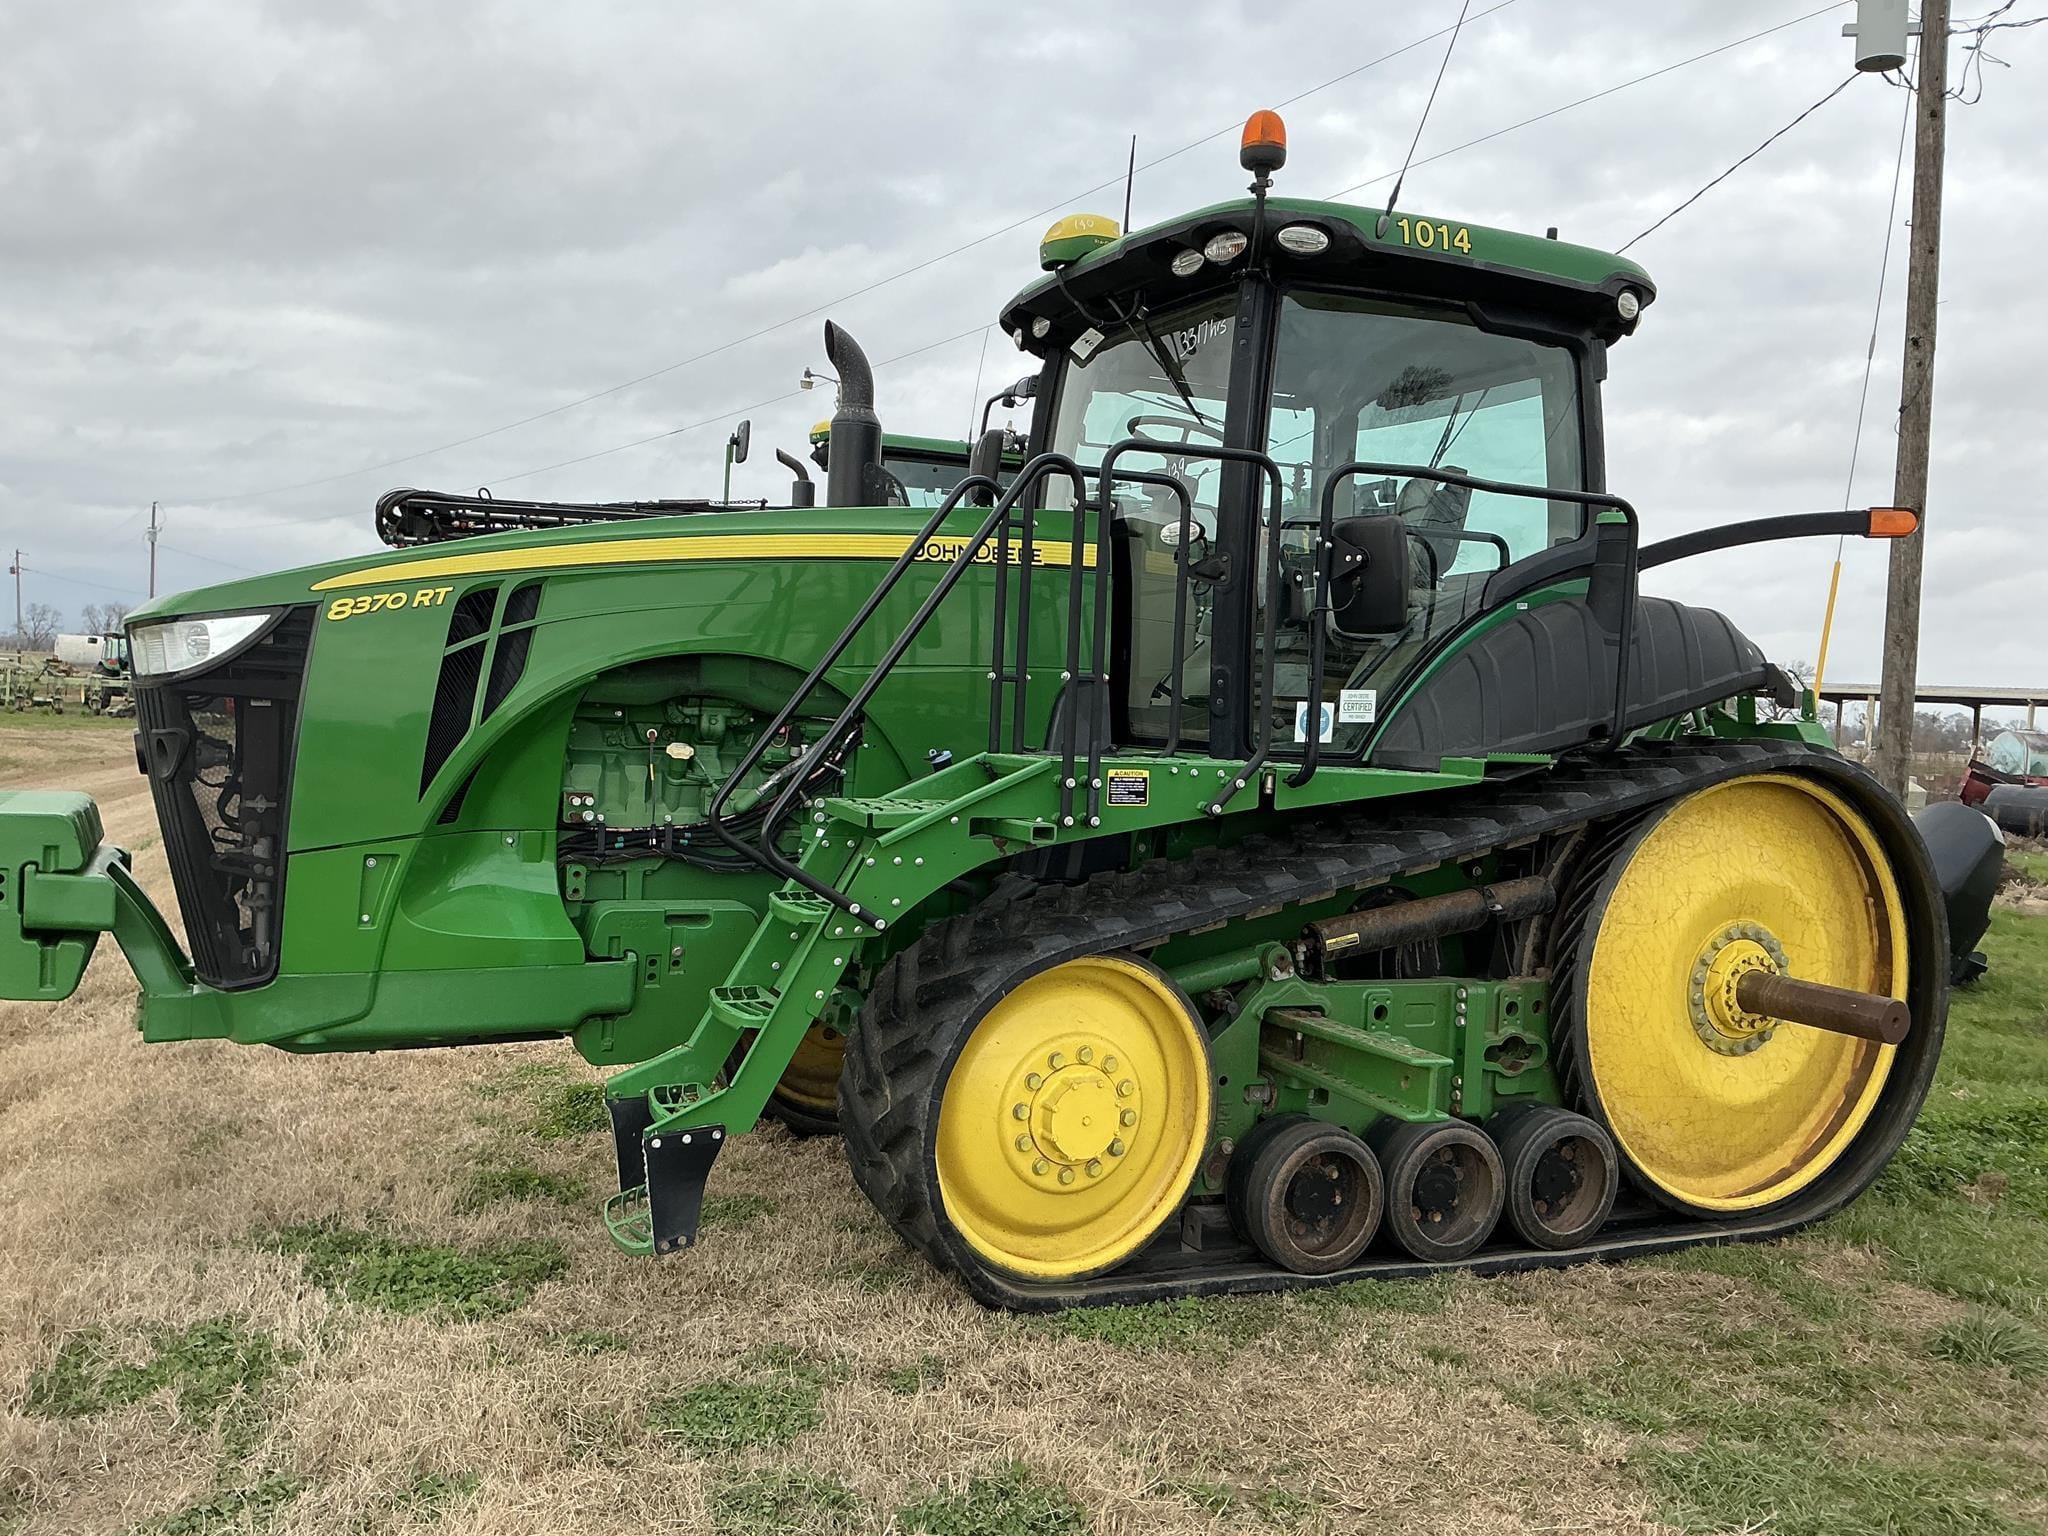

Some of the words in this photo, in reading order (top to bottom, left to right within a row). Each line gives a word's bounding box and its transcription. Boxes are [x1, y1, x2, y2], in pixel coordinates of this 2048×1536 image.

[1397, 217, 1472, 255] 1014
[327, 592, 408, 621] 8370
[412, 586, 454, 608] RT
[1343, 702, 1373, 711] CERTIFIED
